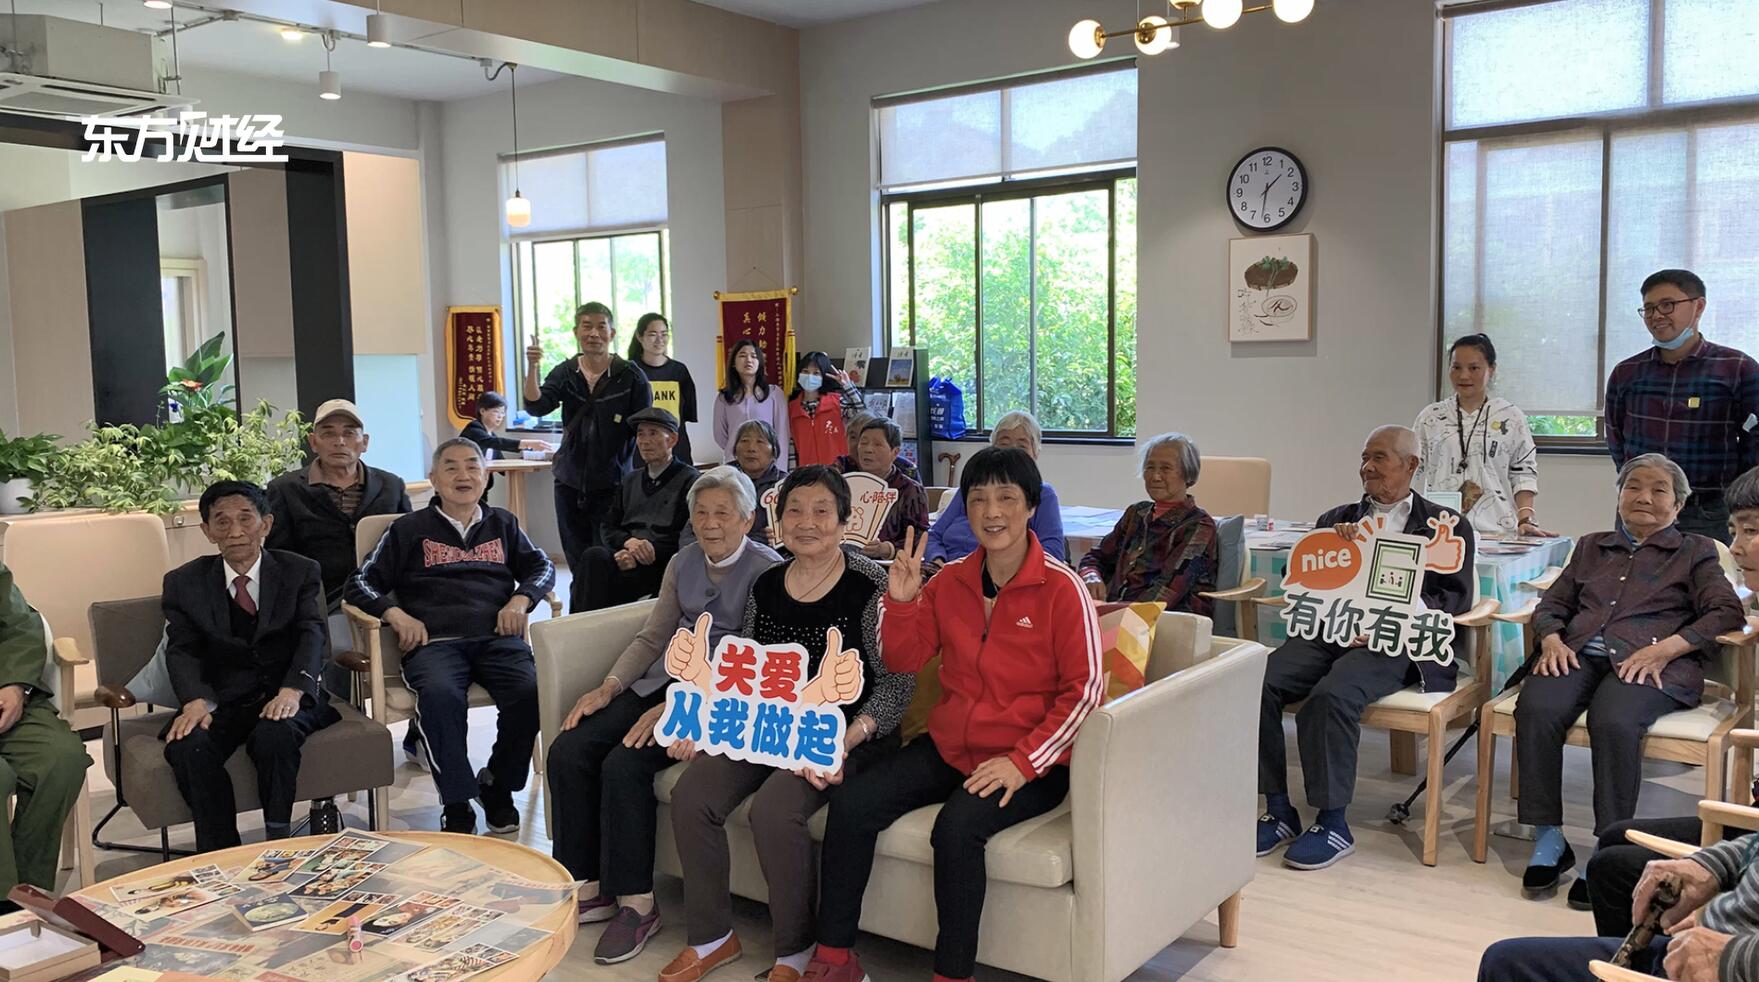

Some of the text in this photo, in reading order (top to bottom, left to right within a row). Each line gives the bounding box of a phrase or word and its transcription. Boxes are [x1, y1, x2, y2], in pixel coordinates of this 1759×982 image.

[1262, 156, 1272, 166] 12
[1280, 159, 1284, 168] 1
[1249, 162, 1258, 172] 11
[1288, 167, 1294, 178] 2
[1240, 174, 1250, 184] 10
[1292, 182, 1299, 192] 3
[1236, 188, 1243, 198] 9
[1288, 196, 1294, 206] 4
[1241, 202, 1247, 211] 8
[1250, 210, 1257, 220] 7
[1278, 208, 1286, 218] 5
[1264, 214, 1271, 223] 6
[1301, 547, 1352, 573] nice
[1284, 591, 1452, 662] 有你有我
[716, 643, 802, 703] 关爱
[662, 690, 839, 767] 从我做起
